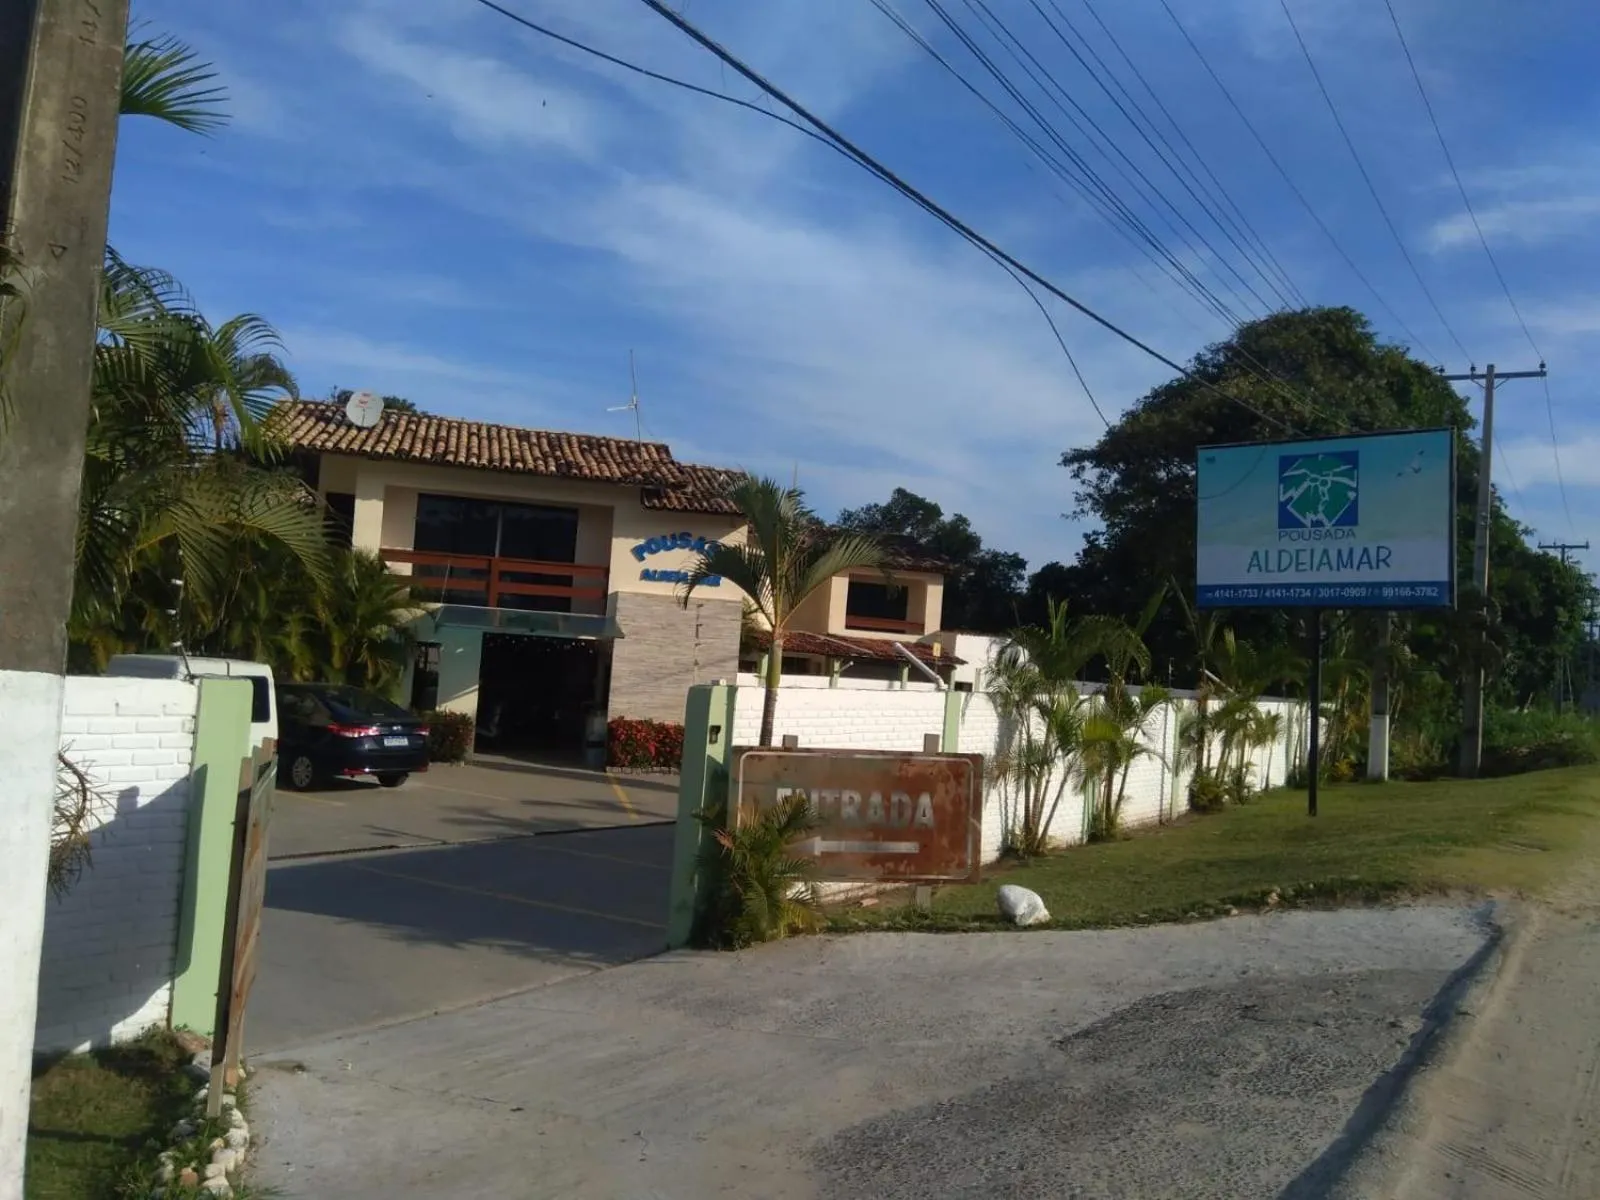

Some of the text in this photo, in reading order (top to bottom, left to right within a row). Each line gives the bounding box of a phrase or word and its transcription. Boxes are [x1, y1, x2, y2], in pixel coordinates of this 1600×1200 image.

[1278, 528, 1356, 542] POUSADA
[630, 531, 722, 562] POUSA
[1247, 546, 1393, 574] ALDEIAMAR
[1265, 587, 1312, 598] 4141-1734
